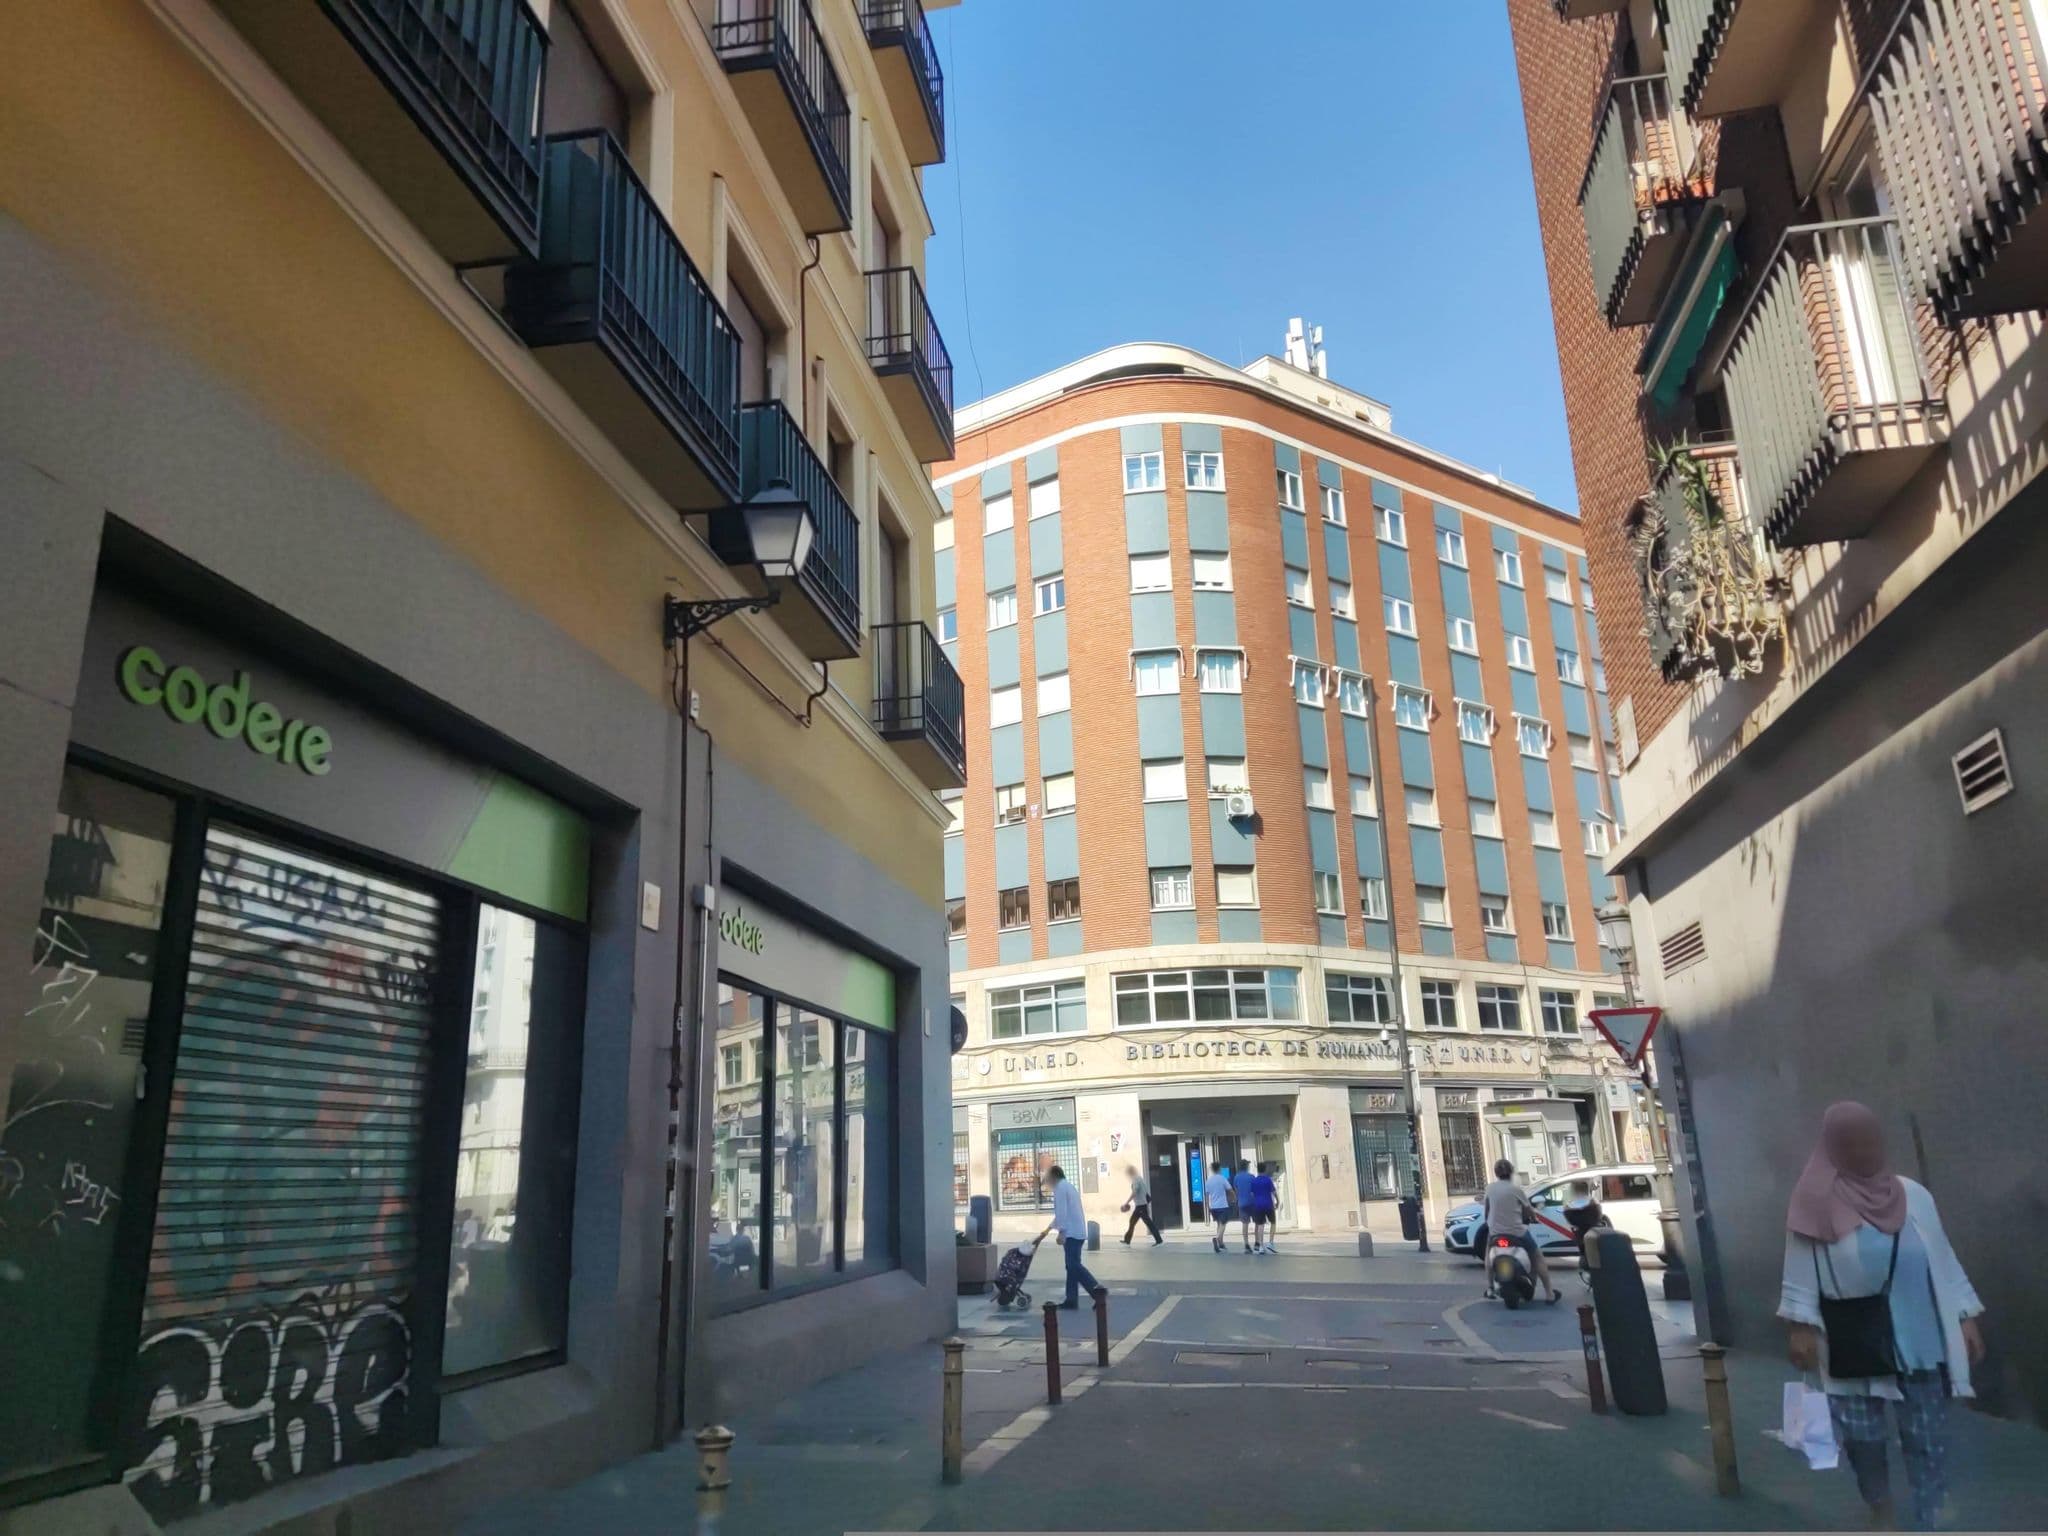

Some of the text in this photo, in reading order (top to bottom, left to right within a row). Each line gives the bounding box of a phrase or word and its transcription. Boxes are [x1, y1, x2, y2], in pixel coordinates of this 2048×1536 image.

[118, 645, 332, 776] codere
[719, 905, 764, 955] odere
[1126, 1040, 1272, 1061] BIBLIOTECA
[1281, 1040, 1310, 1058] DE
